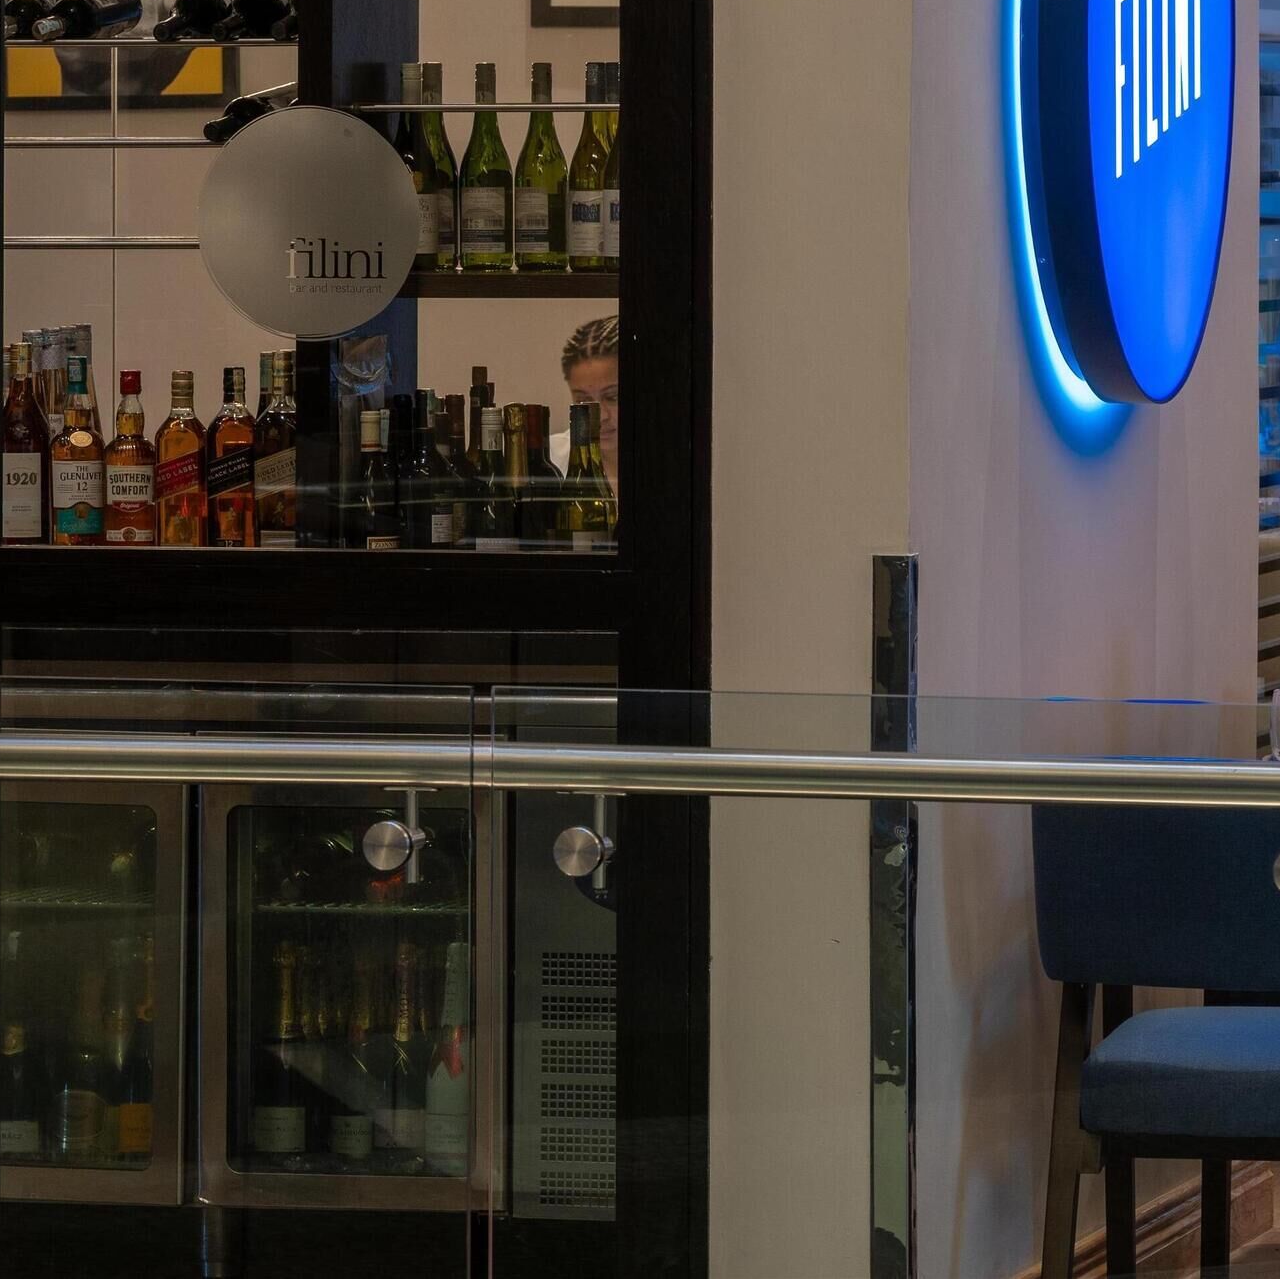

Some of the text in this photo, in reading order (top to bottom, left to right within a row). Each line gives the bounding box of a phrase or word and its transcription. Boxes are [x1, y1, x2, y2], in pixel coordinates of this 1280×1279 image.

[284, 237, 387, 279] filini
[289, 281, 383, 294] bar and restaurant
[173, 464, 198, 477] LABEL
[228, 463, 250, 473] LABEL
[6, 472, 38, 486] 1920
[60, 472, 104, 481] GLENLIVET
[109, 473, 150, 484] SOUTHERN
[77, 481, 88, 491] 12
[112, 485, 149, 495] COMFORT
